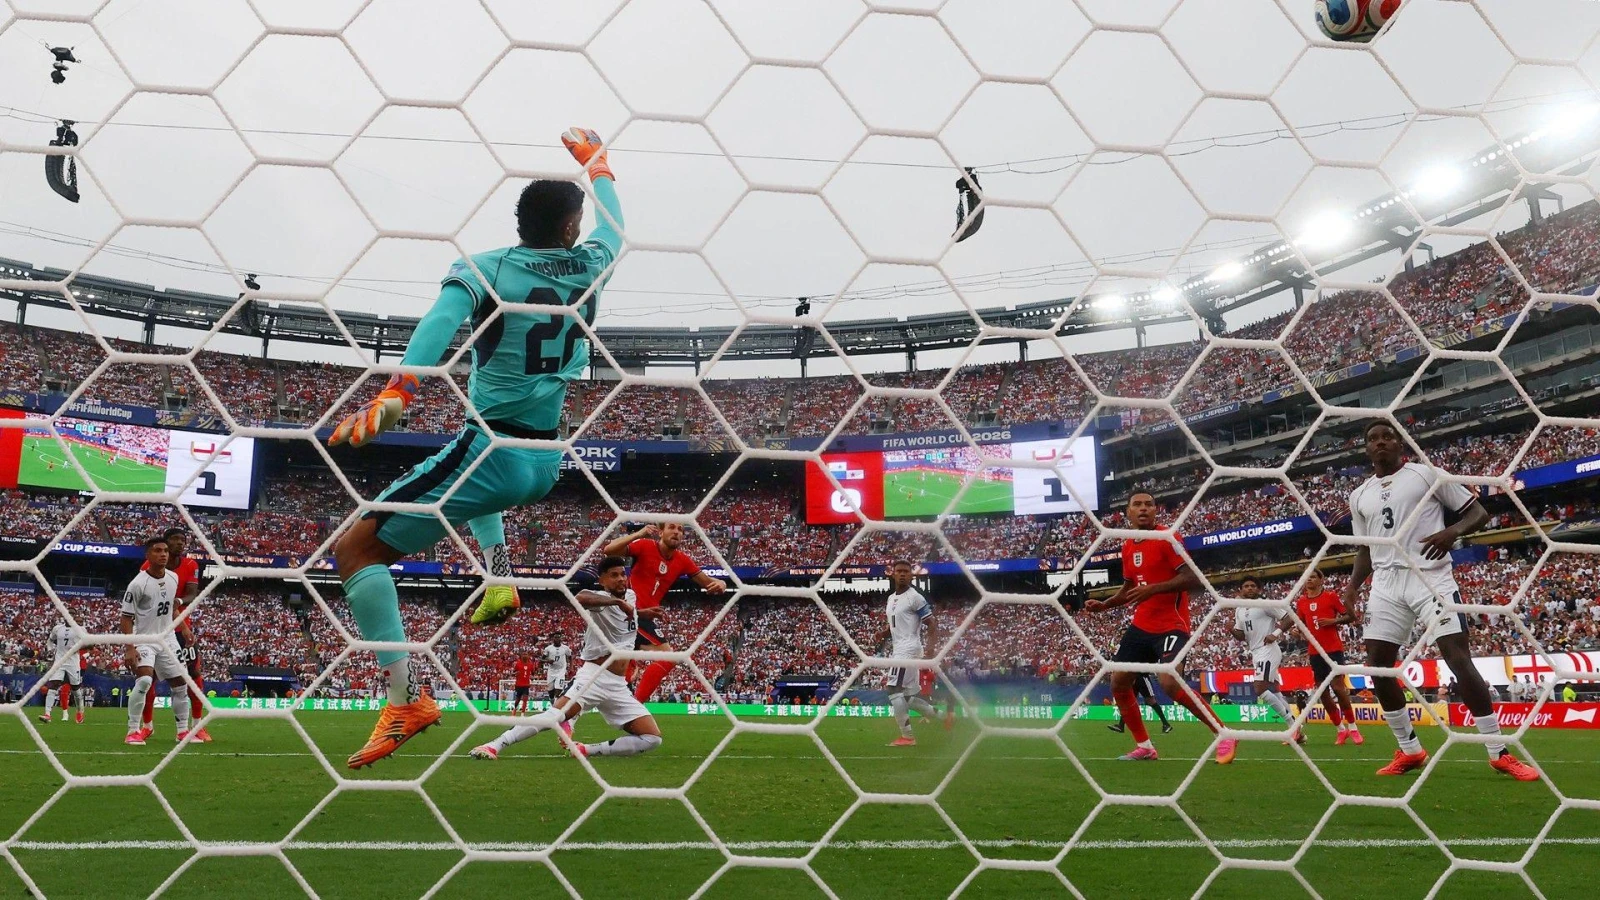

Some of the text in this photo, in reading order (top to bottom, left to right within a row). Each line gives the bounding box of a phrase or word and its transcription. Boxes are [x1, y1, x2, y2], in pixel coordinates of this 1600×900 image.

[525, 287, 597, 375] 22
[69, 402, 133, 420] #FIFAWorldCup
[1152, 405, 1235, 432] NEW YOK NEW JERSEY
[883, 431, 1012, 448] FIFA WORLD CU 2026
[562, 446, 617, 458] ORK
[196, 471, 222, 497] 1
[1043, 478, 1070, 503] 1
[830, 489, 862, 513] 0
[1382, 507, 1394, 530] 3
[1203, 521, 1294, 546] FIFA WORLD CUP 2026
[63, 544, 84, 553] CUP
[84, 546, 119, 555] 2026
[245, 556, 274, 564] JERSEY
[701, 569, 730, 577] 2026
[790, 568, 806, 576] NEW
[844, 567, 871, 575] JERSEY
[157, 601, 170, 617] 26
[63, 638, 70, 647] 7
[1164, 635, 1179, 652] 17
[1402, 661, 1425, 688] 0
[1307, 707, 1326, 720] NEW
[1355, 708, 1378, 720] NEW
